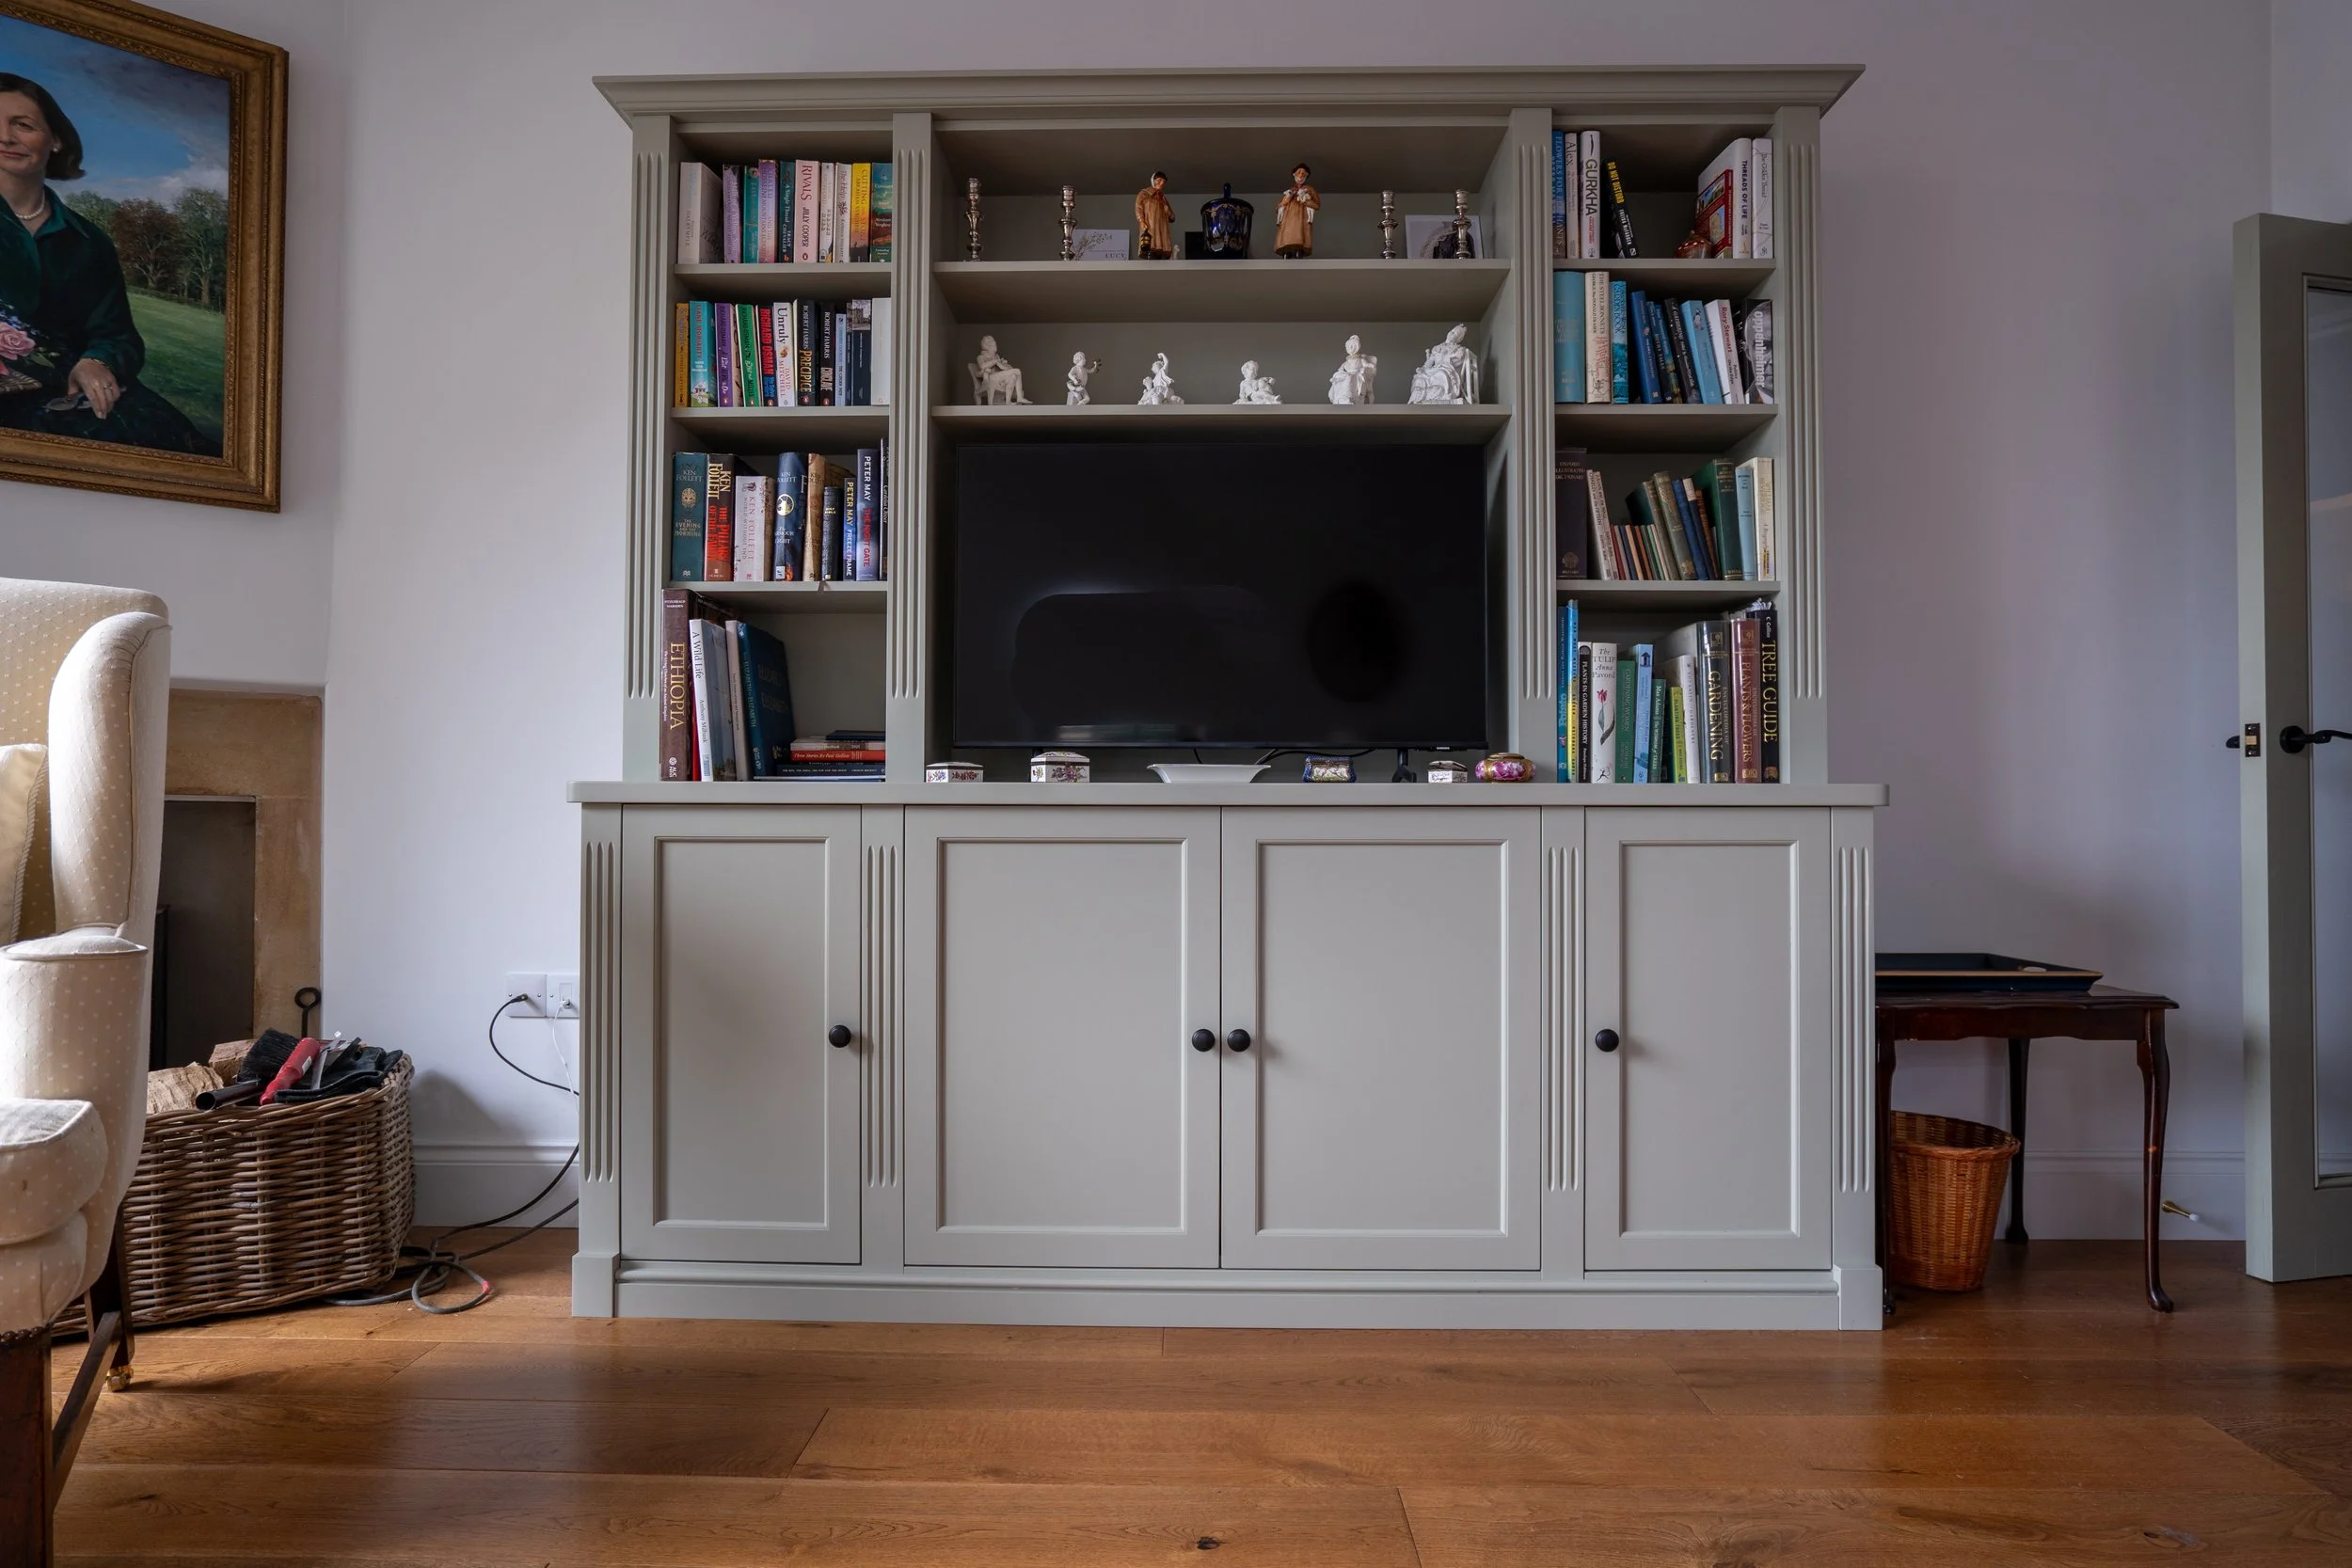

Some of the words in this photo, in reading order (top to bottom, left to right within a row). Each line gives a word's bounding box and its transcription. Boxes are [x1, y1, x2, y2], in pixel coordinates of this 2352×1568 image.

[1555, 135, 1565, 175] FLOWERS
[1565, 141, 1577, 166] Alex
[800, 165, 813, 200] RIVALS
[838, 182, 848, 198] Help
[860, 169, 869, 205] CUTTING
[1584, 158, 1598, 216] GURKHA
[1741, 193, 1748, 202] OF
[802, 206, 810, 222] JILLY
[802, 224, 810, 247] COOPER
[760, 308, 772, 344] RICHARD
[777, 307, 790, 345] Unruly
[1720, 307, 1729, 325] Rory
[823, 335, 832, 359] HARRIS
[1723, 325, 1734, 354] Stewart
[1753, 310, 1767, 388] oppenheimer
[762, 345, 774, 375] OSMAN
[799, 349, 813, 393] PRECIPICE
[707, 463, 723, 500] FOLLETT
[719, 469, 732, 492] KEN
[864, 455, 872, 483] PETER
[847, 482, 855, 508] PETER
[864, 483, 872, 501] MAY
[707, 505, 717, 516] OF
[718, 507, 730, 523] THE
[847, 509, 855, 527] MAY
[864, 507, 872, 524] THE
[716, 523, 731, 562] PILLARS
[747, 520, 755, 561] FOLLETT
[846, 529, 854, 553] FREEZE
[864, 524, 872, 546] NIGHT
[863, 548, 871, 568] GATE
[693, 640, 703, 661] Wild
[1762, 641, 1776, 683] TREE
[695, 663, 705, 680] Life
[1742, 661, 1752, 700] PLANTS
[669, 642, 686, 731] ETHIOPIA
[1624, 668, 1632, 705] GARDENING
[698, 699, 707, 721] Anthony
[1708, 670, 1724, 761] GARDENING
[1742, 703, 1751, 713] &
[1762, 687, 1777, 743] GUIDE
[700, 721, 708, 744] Milbank
[1742, 714, 1753, 763] FLOWERS
